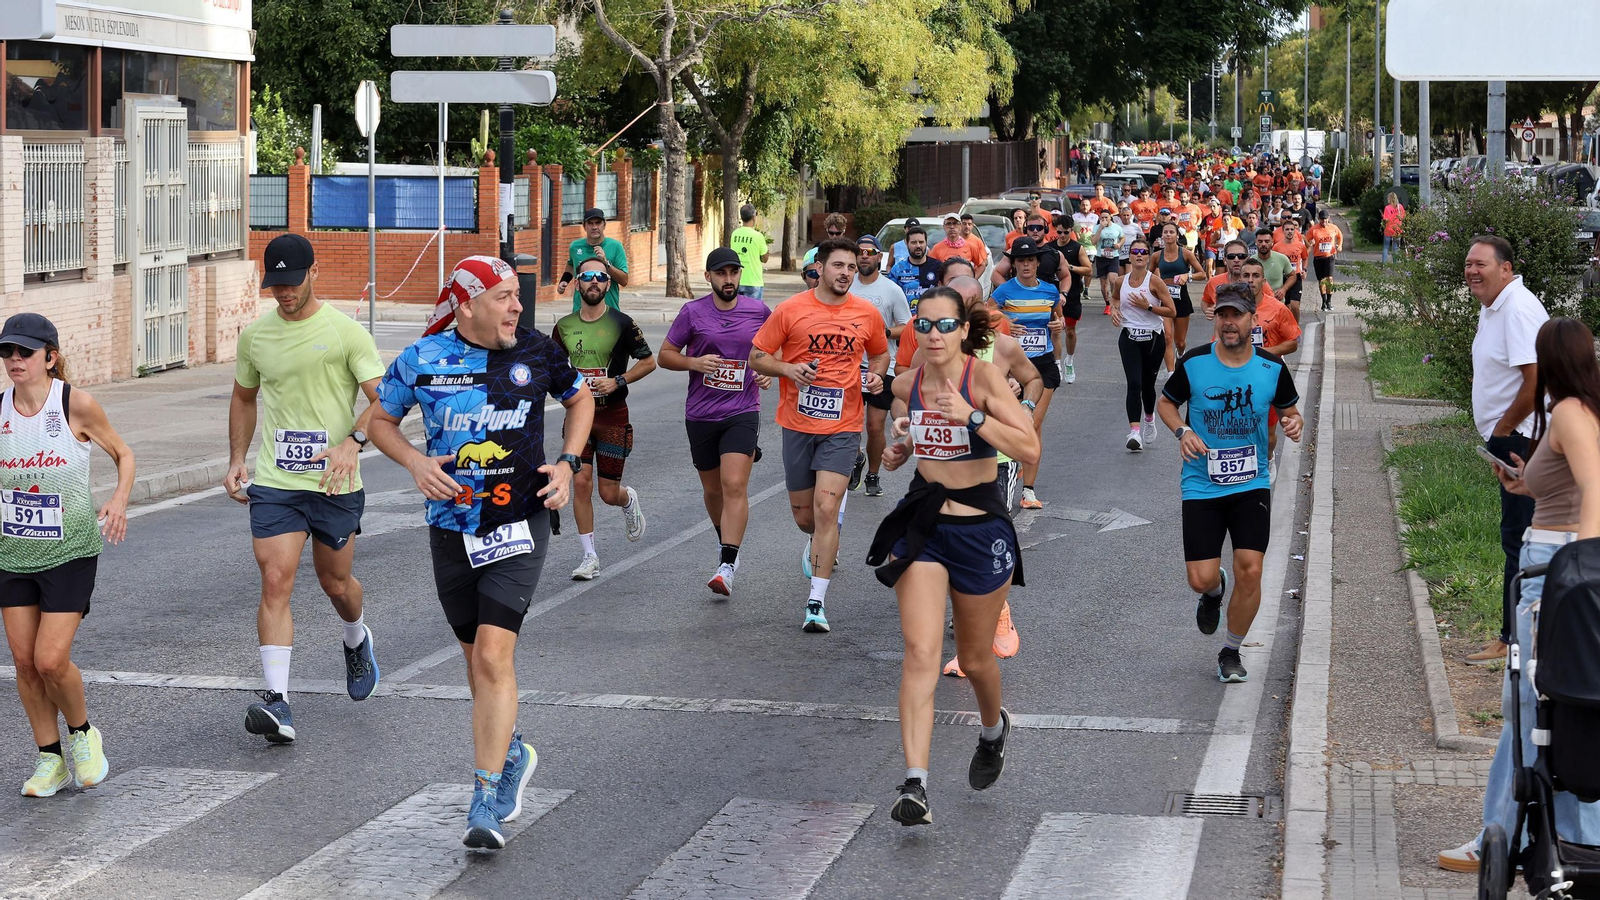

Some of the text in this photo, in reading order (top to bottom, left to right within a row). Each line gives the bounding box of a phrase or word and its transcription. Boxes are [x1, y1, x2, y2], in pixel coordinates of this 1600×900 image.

[734, 236, 753, 244] STAFF
[1022, 336, 1040, 345] 647
[714, 369, 735, 380] 345
[805, 394, 836, 410] 1093
[924, 428, 953, 444] 438
[286, 444, 314, 459] 638
[472, 467, 515, 476] ALQUILERES
[1220, 459, 1246, 473] 857
[13, 473, 46, 481] JEREZ
[15, 507, 44, 524] 591
[482, 524, 513, 547] 667
